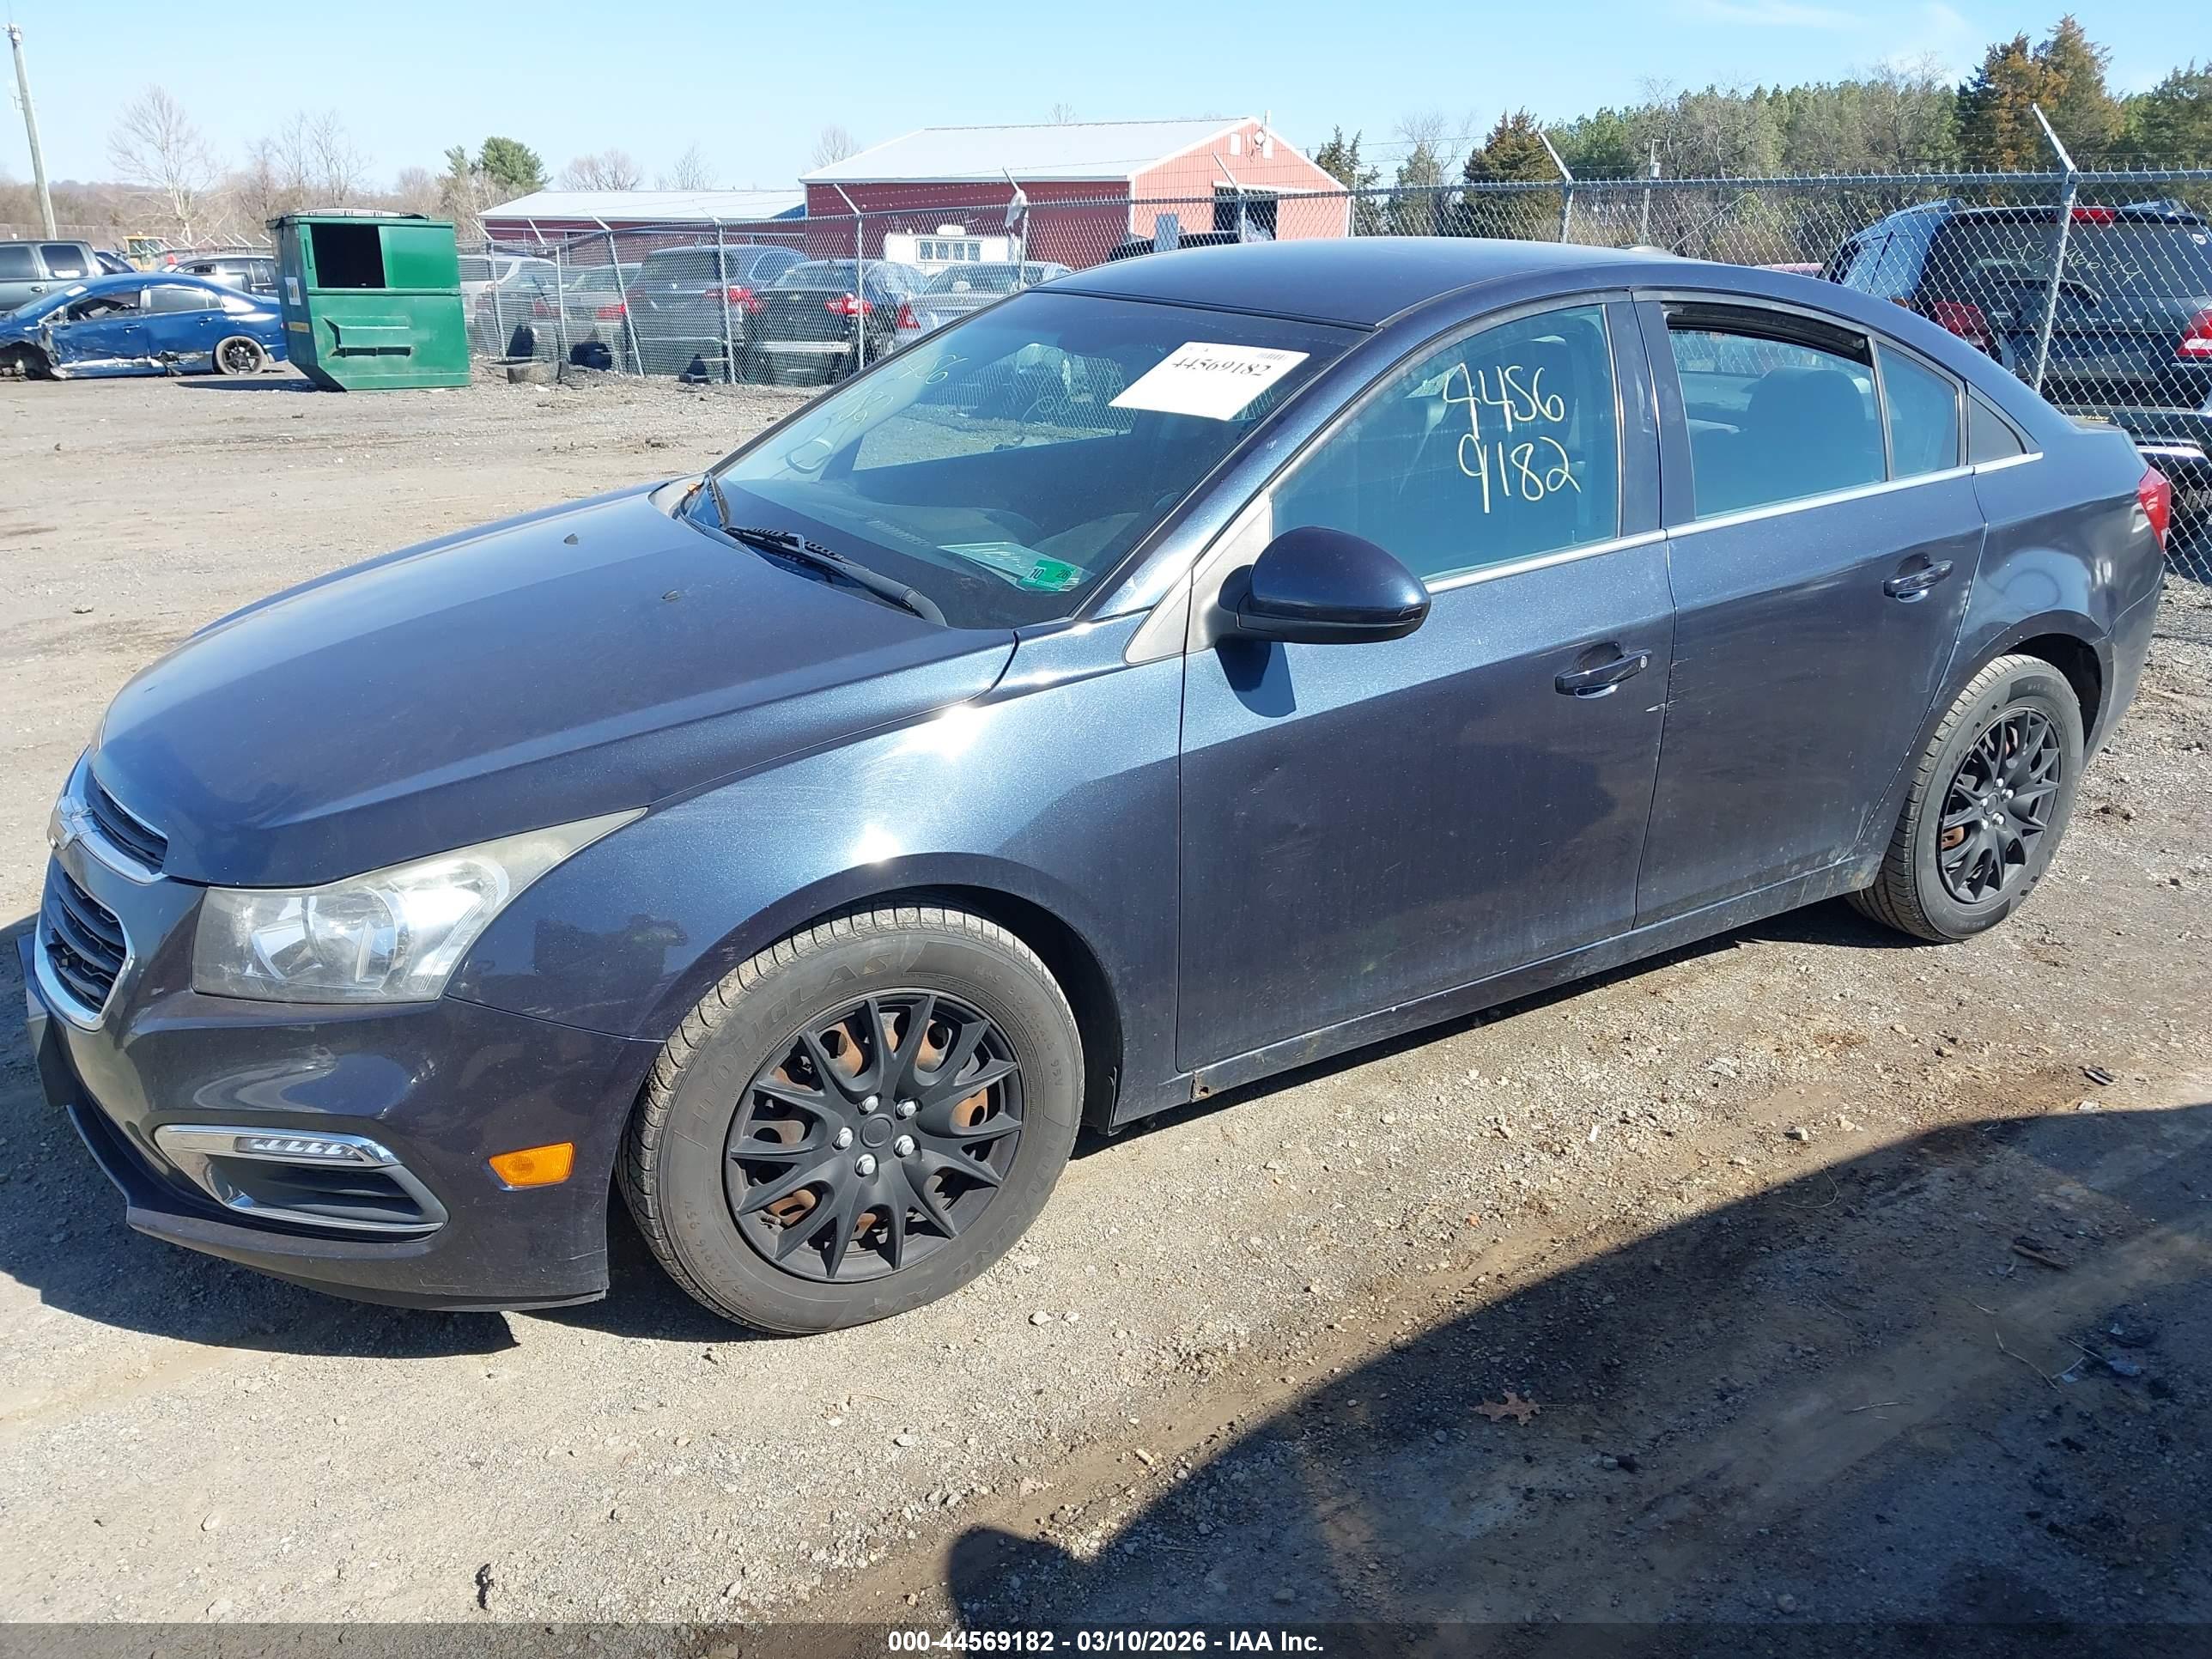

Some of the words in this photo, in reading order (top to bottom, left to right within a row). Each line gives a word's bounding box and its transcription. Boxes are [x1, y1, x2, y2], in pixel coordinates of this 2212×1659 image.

[1172, 348, 1272, 377] 44569182
[1443, 362, 1565, 440] 4456
[1458, 433, 1582, 514] 9182
[1030, 568, 1045, 580] 10
